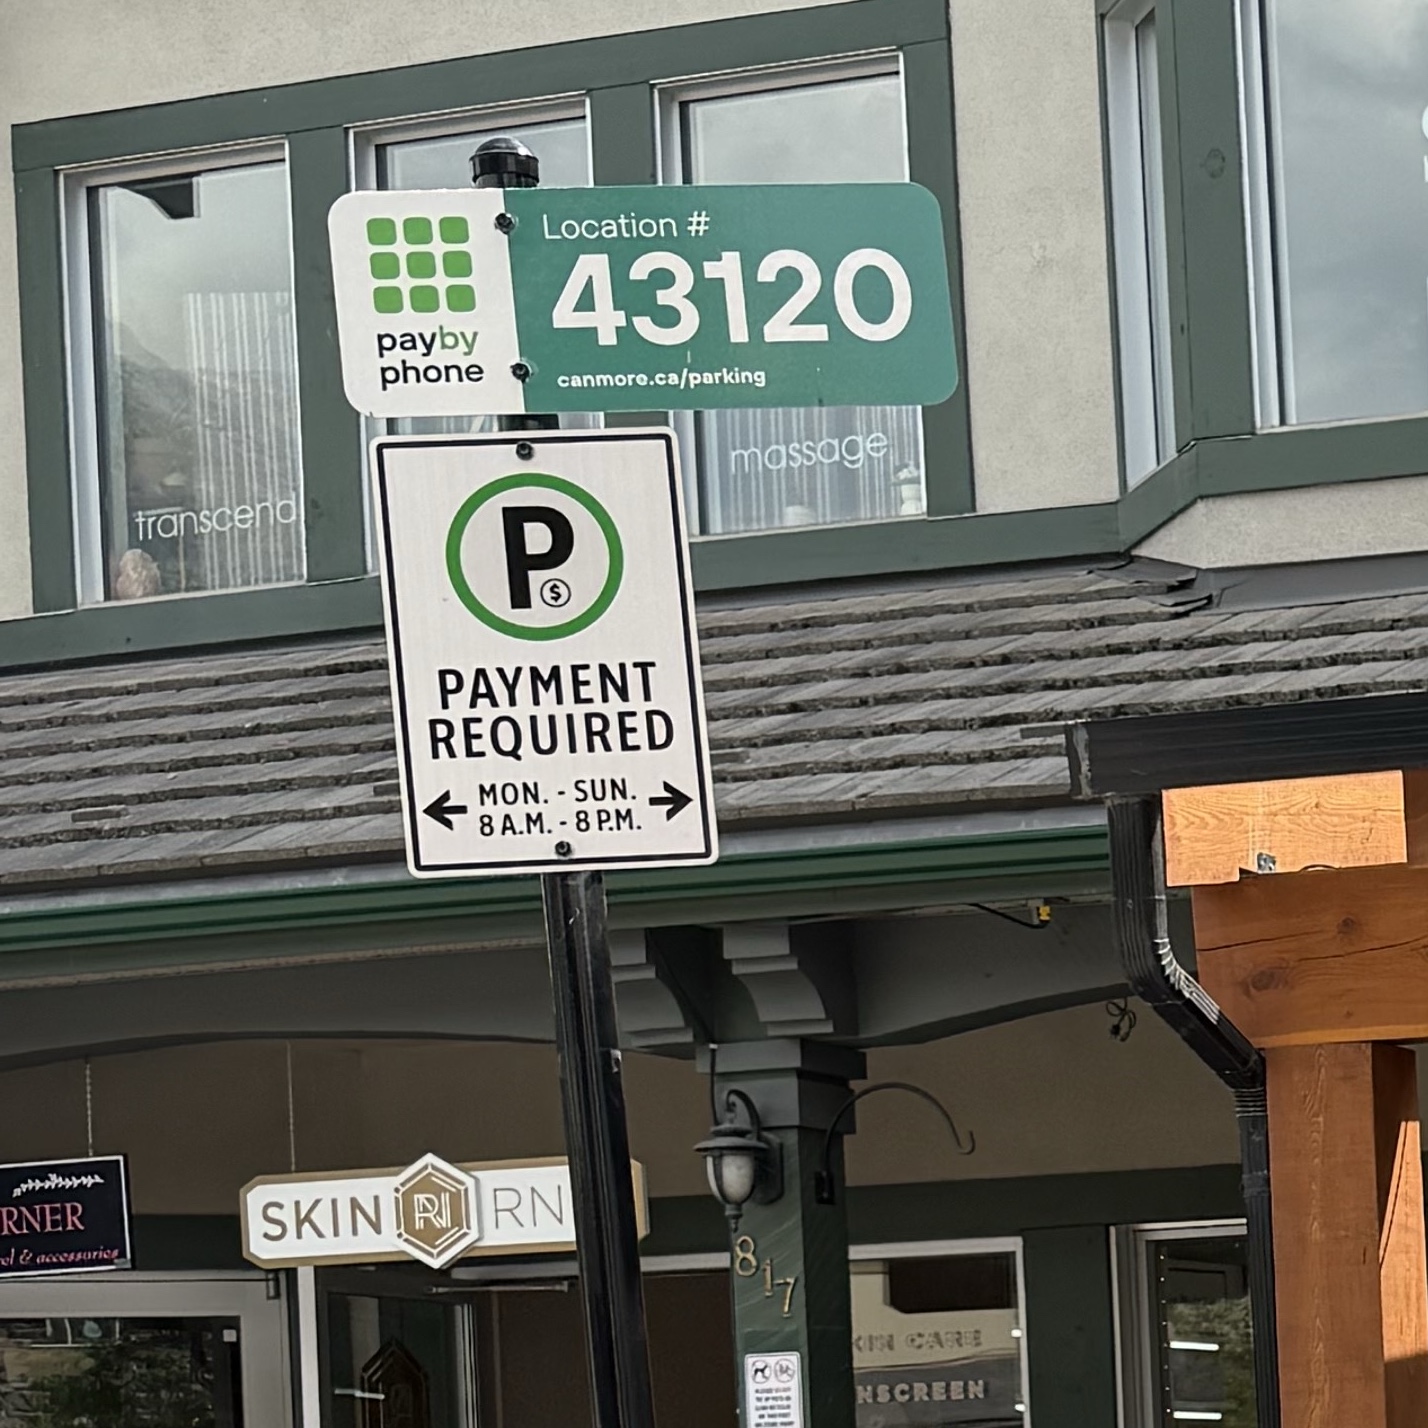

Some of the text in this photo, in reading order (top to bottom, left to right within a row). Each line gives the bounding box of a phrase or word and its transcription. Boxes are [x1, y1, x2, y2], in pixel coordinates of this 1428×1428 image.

[542, 210, 711, 241] Location #
[551, 247, 912, 346] 43120
[376, 325, 480, 357] payby
[380, 357, 486, 391] phone
[557, 366, 767, 390] canmore.ca/parking
[730, 427, 889, 476] massage
[134, 492, 297, 541] transcend
[500, 505, 575, 610] P
[437, 660, 657, 711] PAYMENT
[427, 709, 676, 761] REQUIRED
[478, 781, 549, 806] MON.
[573, 779, 638, 802] SUN.
[479, 814, 496, 836] 8
[499, 811, 553, 834] A.M.
[574, 810, 591, 832] 8
[597, 807, 643, 831] P.M.
[261, 1194, 382, 1242] SKIN
[493, 1184, 563, 1230] RN
[36, 1245, 120, 1265] accessories
[735, 1235, 798, 1318] 817
